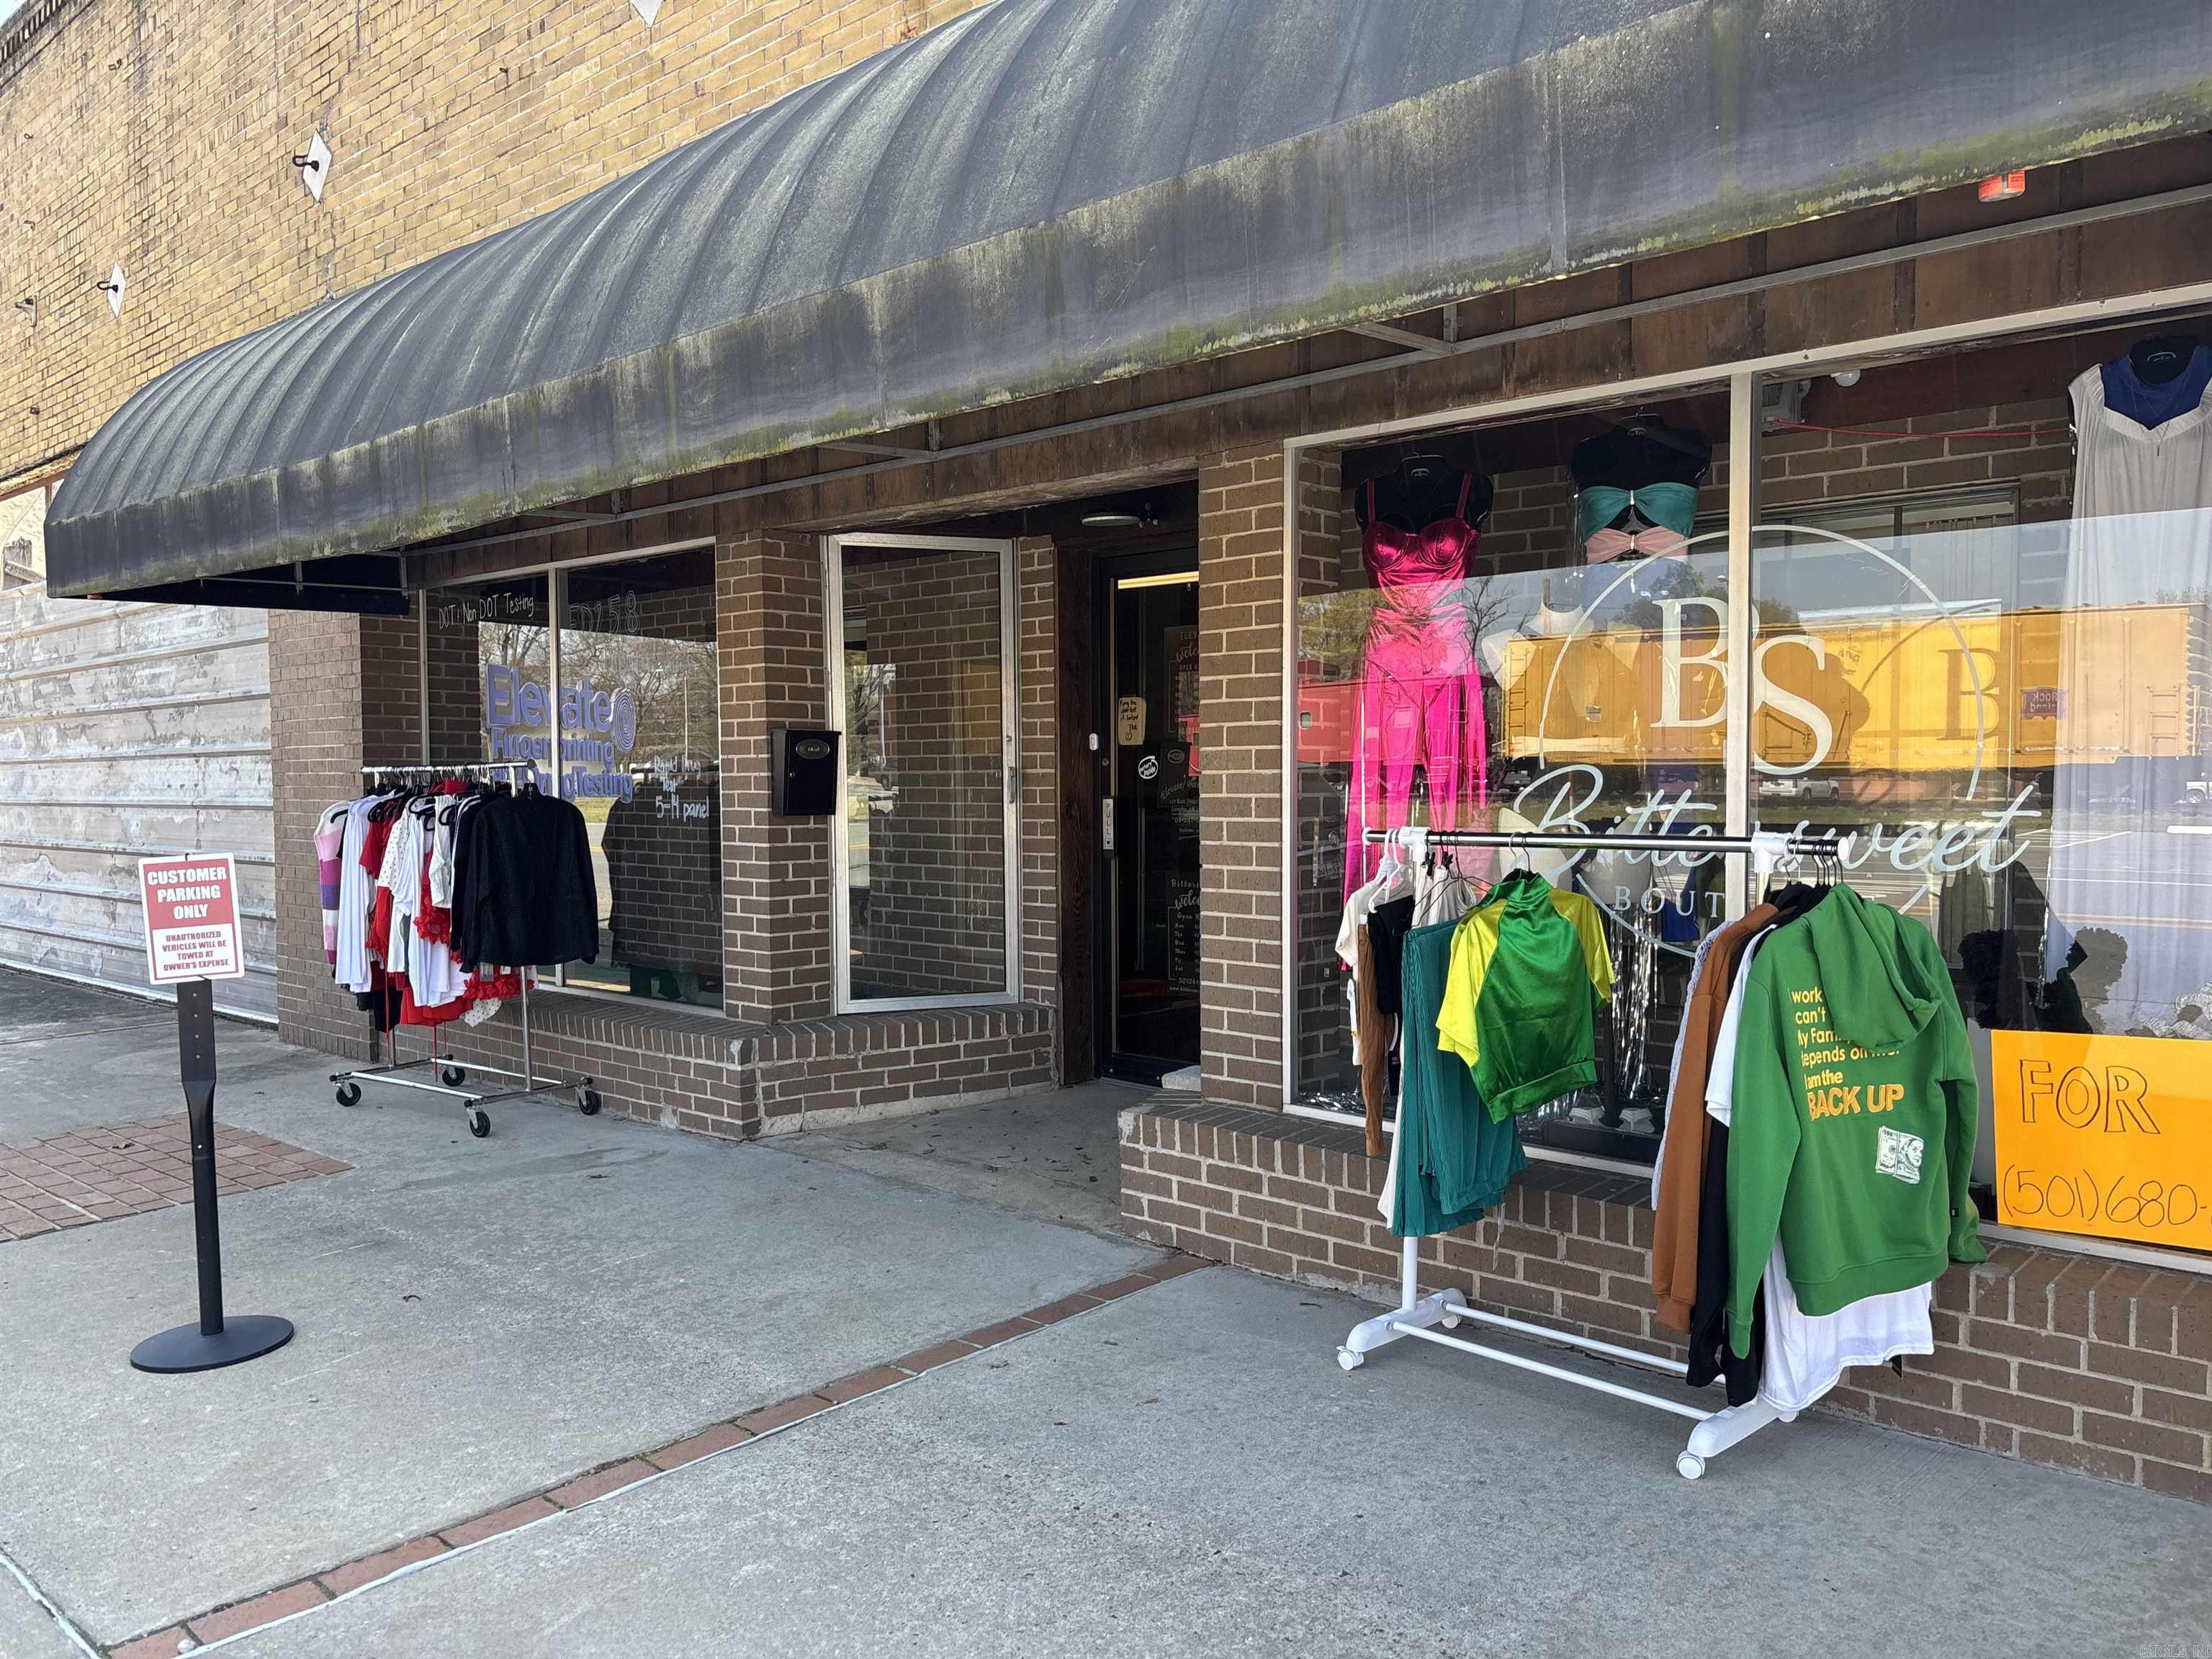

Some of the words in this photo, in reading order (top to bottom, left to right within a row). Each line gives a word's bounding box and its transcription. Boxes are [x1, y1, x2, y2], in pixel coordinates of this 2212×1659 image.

[439, 604, 455, 629] DOT
[479, 594, 499, 619] DOT
[503, 592, 534, 617] Testing
[486, 664, 611, 732] Elevate
[573, 766, 633, 804] Testing
[683, 795, 709, 824] panel
[1513, 764, 2042, 877] Bittesweet
[147, 866, 227, 886] CUSTOMER
[157, 885, 221, 903] PARKING
[1613, 886, 1723, 918] BOUT
[173, 904, 208, 920] ONLY
[162, 941, 197, 953] VEHICLES
[198, 940, 217, 950] WILL
[166, 931, 221, 943] UNAUTHORIZED
[163, 961, 197, 972] OWNER'S
[198, 958, 229, 968] EXPENSE
[176, 951, 204, 961] TOWED
[204, 950, 214, 959] AT
[1791, 986, 1823, 1004] work
[1795, 1006, 1825, 1025] can't
[1850, 1048, 1867, 1060] on
[1807, 1074, 1822, 1089] am
[1821, 1069, 1844, 1086] the
[1807, 1086, 1861, 1121] BACK
[1866, 1083, 1905, 1113] UP
[2020, 1059, 2160, 1134] FOR
[2003, 1164, 2212, 1227] (501)680-
